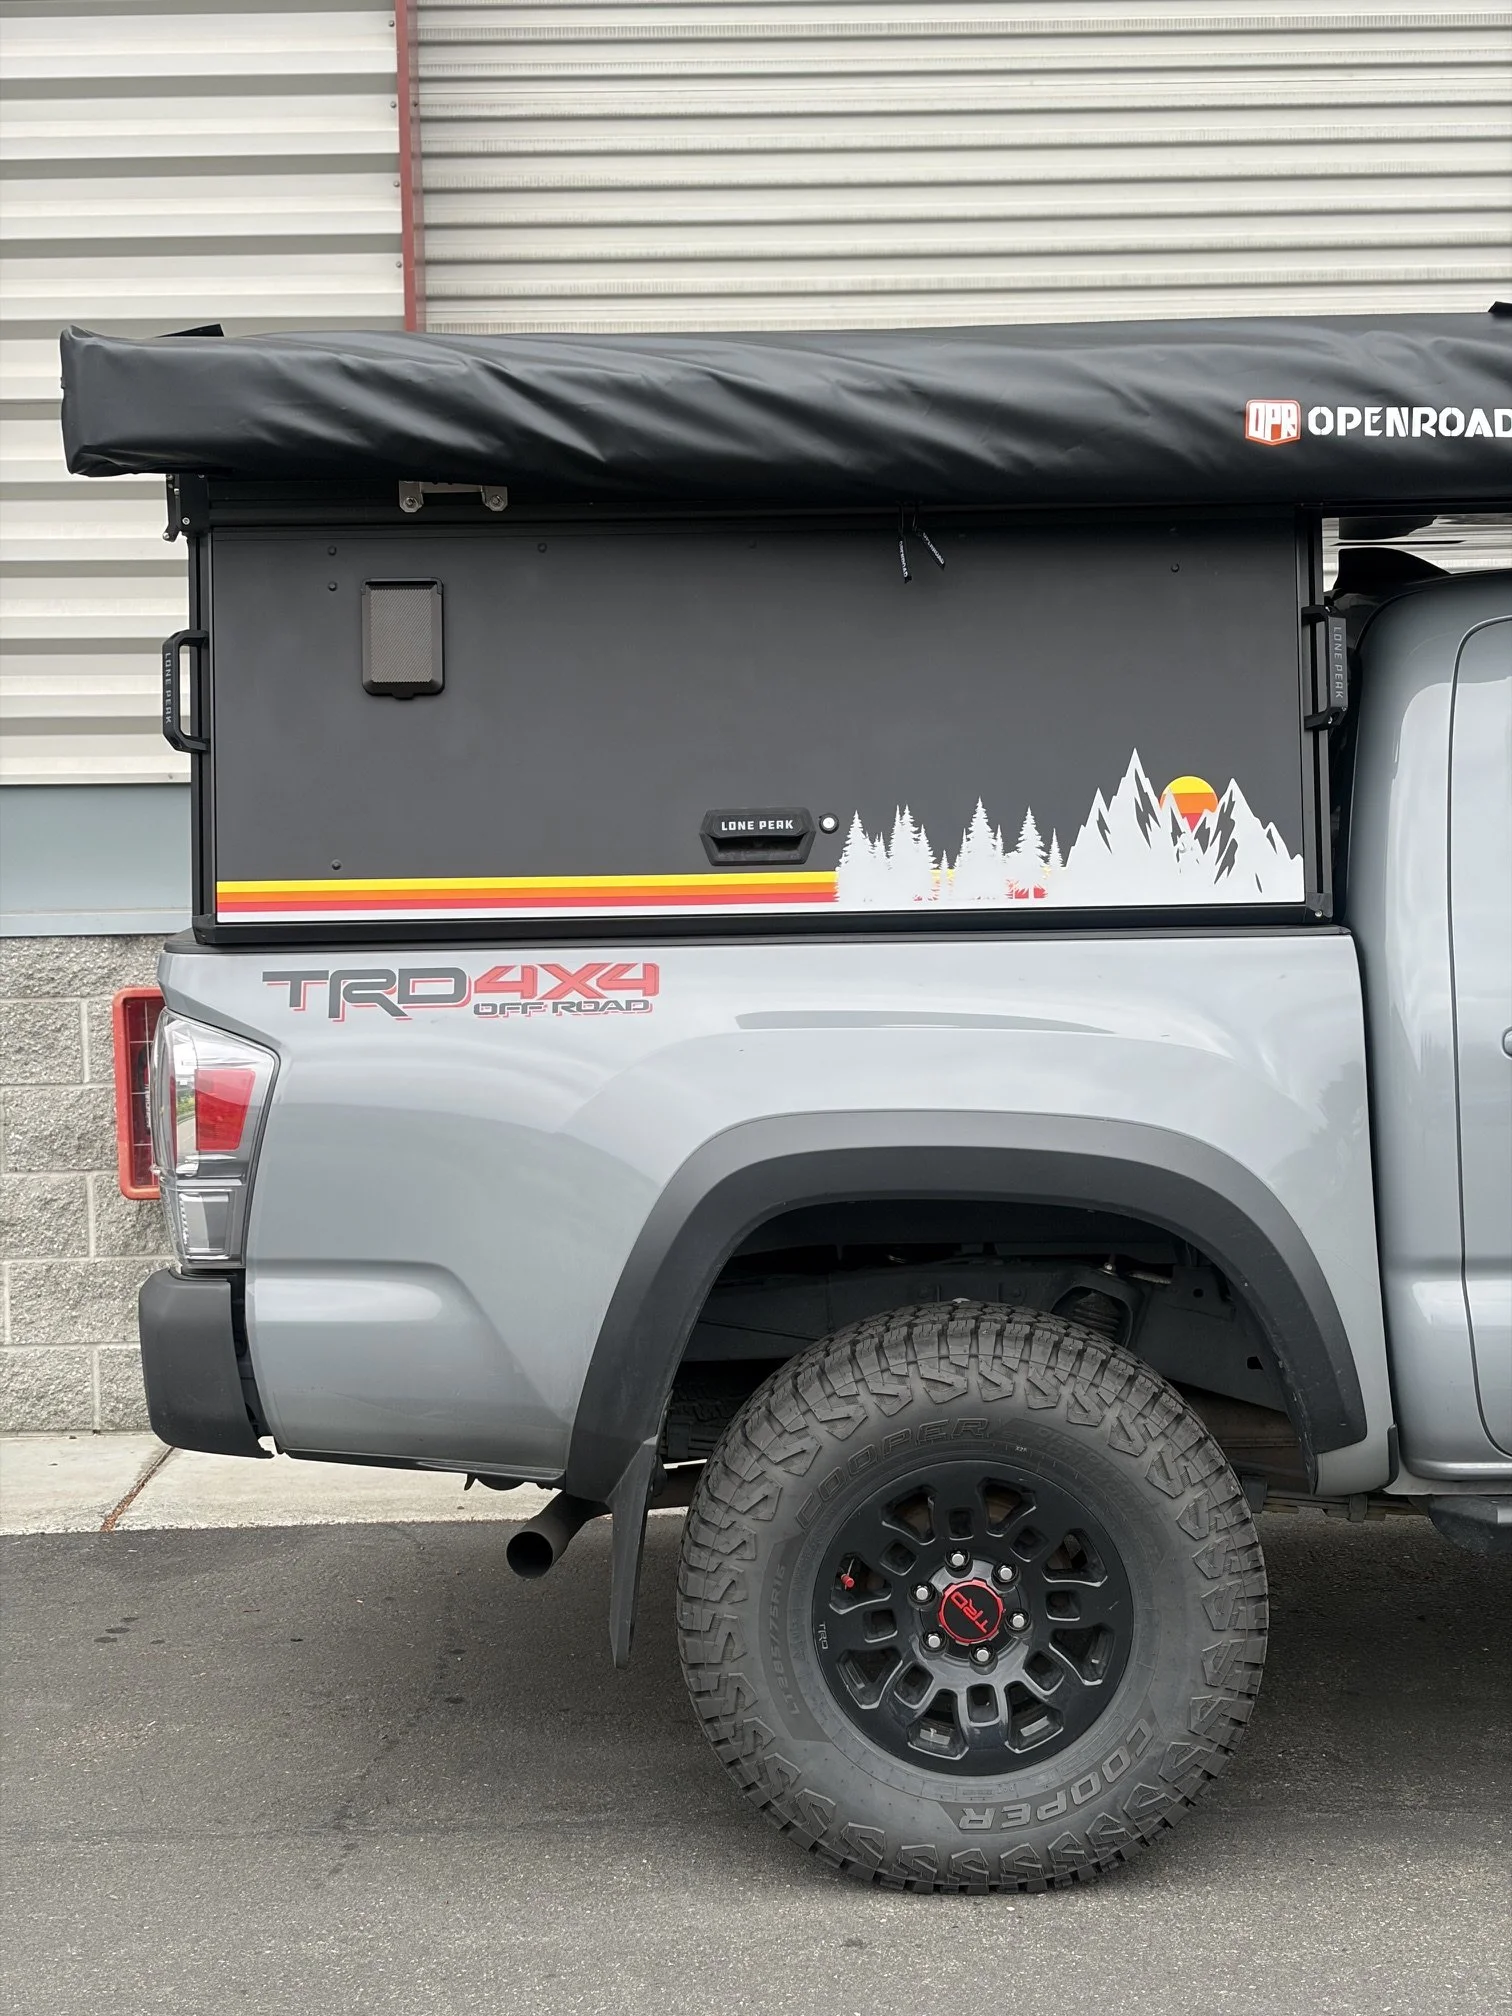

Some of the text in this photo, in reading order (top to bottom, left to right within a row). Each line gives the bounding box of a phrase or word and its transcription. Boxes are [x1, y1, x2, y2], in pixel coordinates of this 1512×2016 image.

[1307, 406, 1512, 438] OPENROAD
[1333, 626, 1344, 698] LONE PEAK
[721, 820, 793, 831] LONE PEAK
[261, 962, 661, 1022] TRD 4X4
[473, 999, 654, 1018] OFF ROAD
[796, 1417, 990, 1530] COOPER
[950, 1591, 989, 1634] TRD
[817, 1621, 829, 1650] TRD
[958, 1718, 1154, 1830] COOPER
